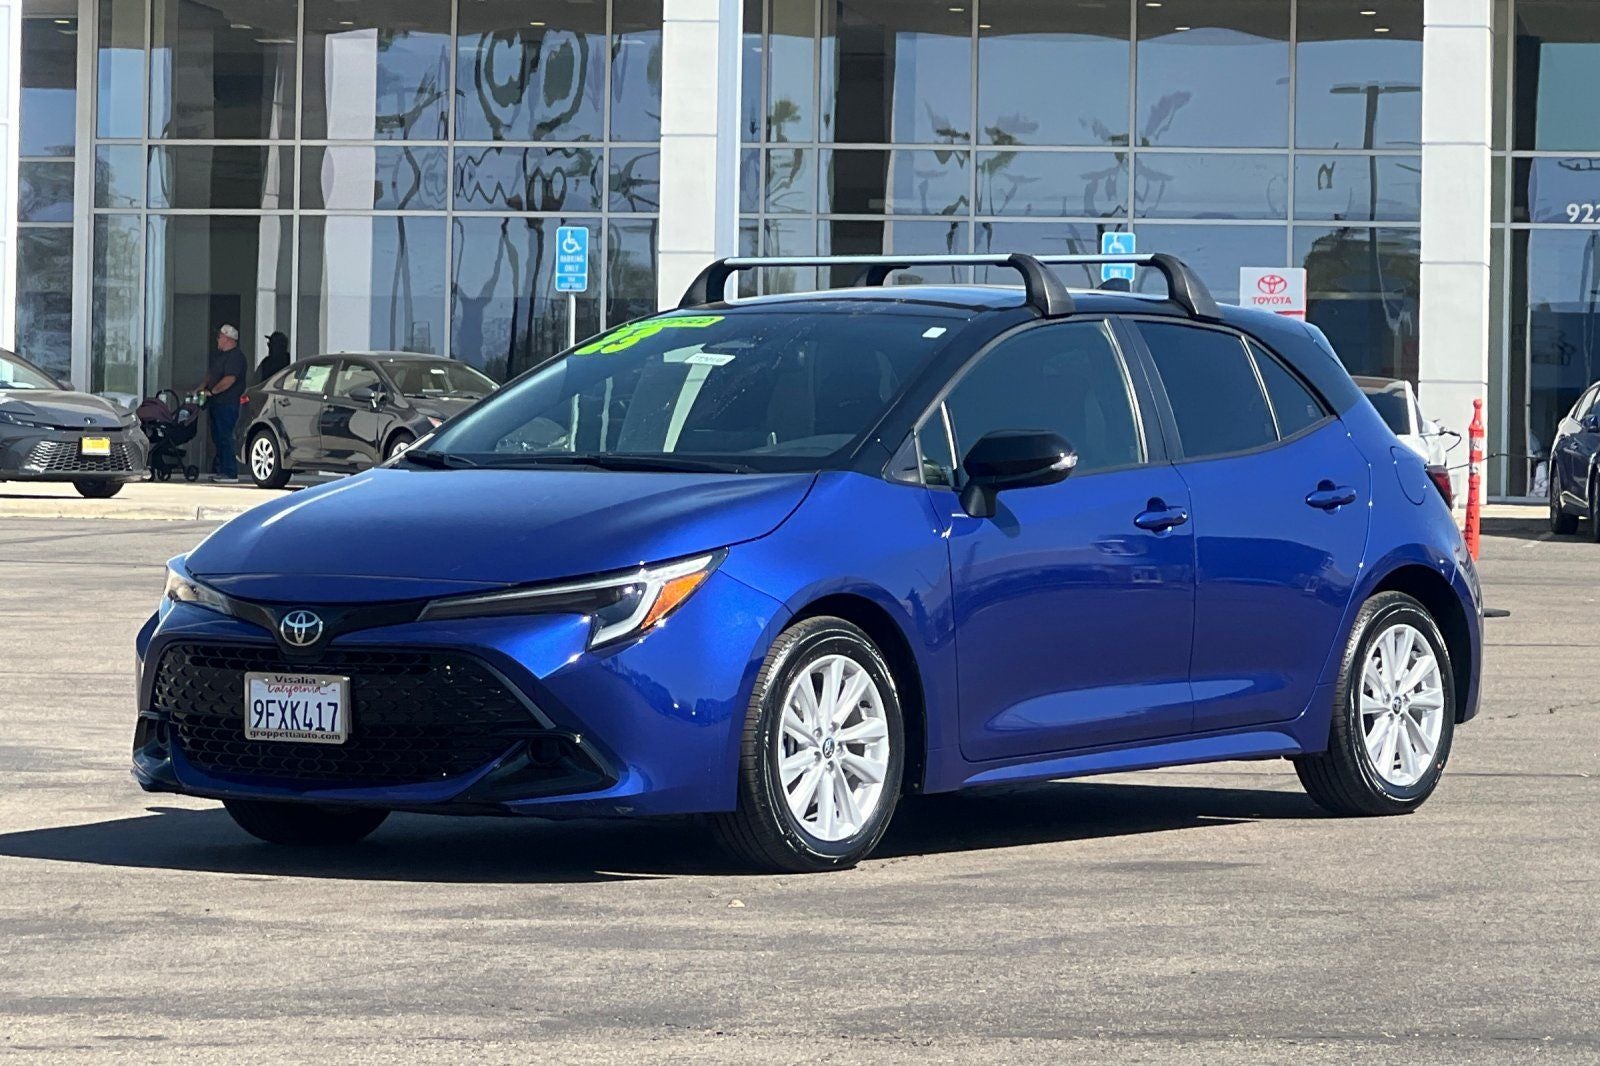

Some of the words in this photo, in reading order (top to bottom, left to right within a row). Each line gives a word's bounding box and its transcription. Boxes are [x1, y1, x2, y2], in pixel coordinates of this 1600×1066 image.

[559, 254, 585, 263] PARKING
[564, 264, 579, 272] ONLY
[1252, 296, 1292, 305] TOYOTA
[275, 675, 316, 684] Visalia
[267, 683, 321, 698] California
[253, 698, 339, 732] 9FXK417
[249, 729, 341, 740] groppettiauto.com
